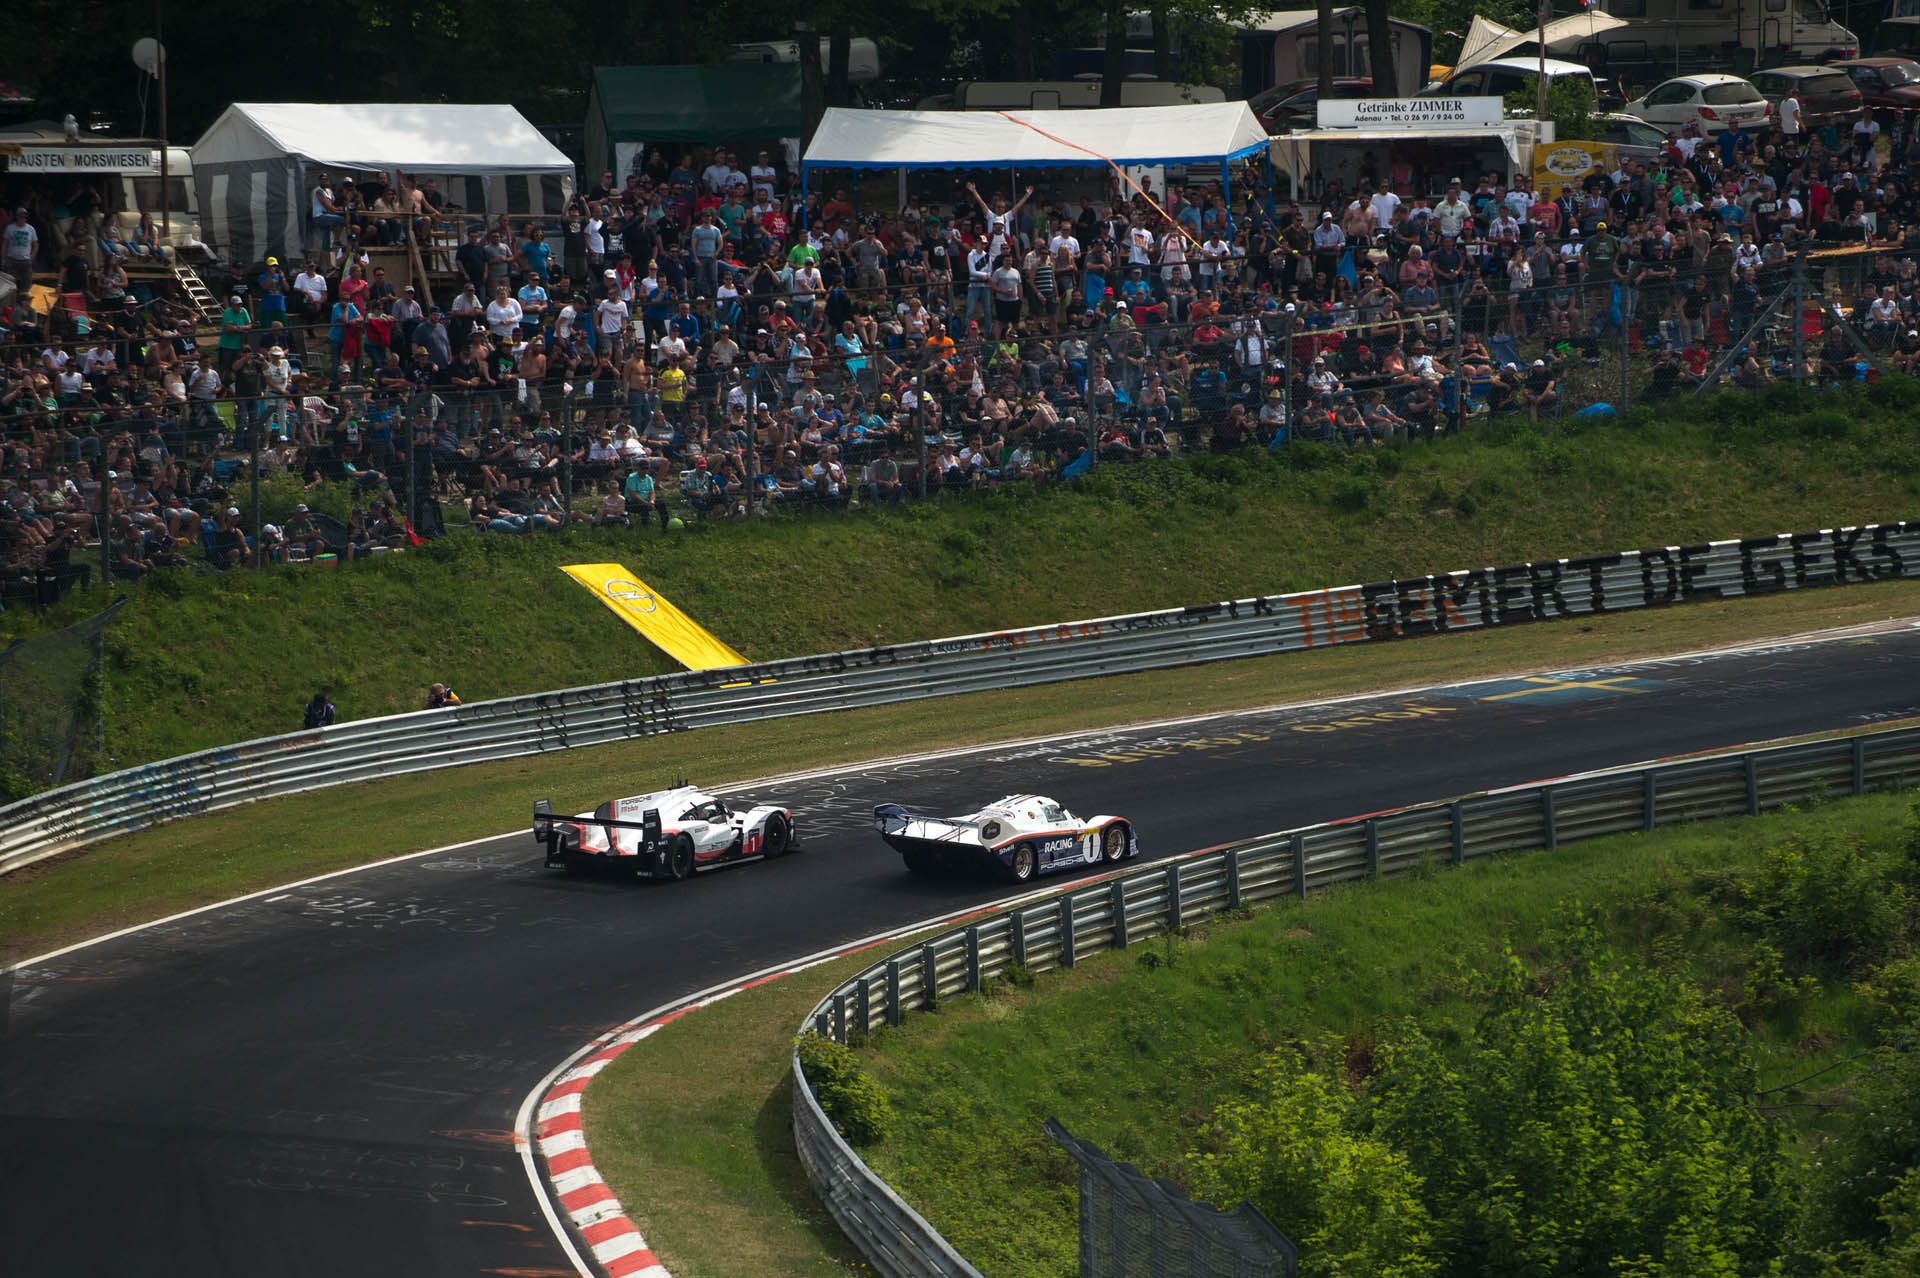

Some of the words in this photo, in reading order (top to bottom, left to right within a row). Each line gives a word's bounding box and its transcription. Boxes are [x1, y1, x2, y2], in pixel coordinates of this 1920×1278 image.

[1357, 101, 1407, 113] Getränke
[1409, 100, 1463, 112] ZIMMER
[11, 153, 65, 167] HAUSTEN
[74, 153, 150, 167] MORSWIESEN
[1290, 702, 1457, 733] VOLVO
[620, 795, 652, 805] PORSCHE
[751, 836, 756, 852] 1
[1044, 838, 1073, 853] RACING
[1089, 835, 1094, 858] 1
[1041, 856, 1084, 870] PORSCHE
